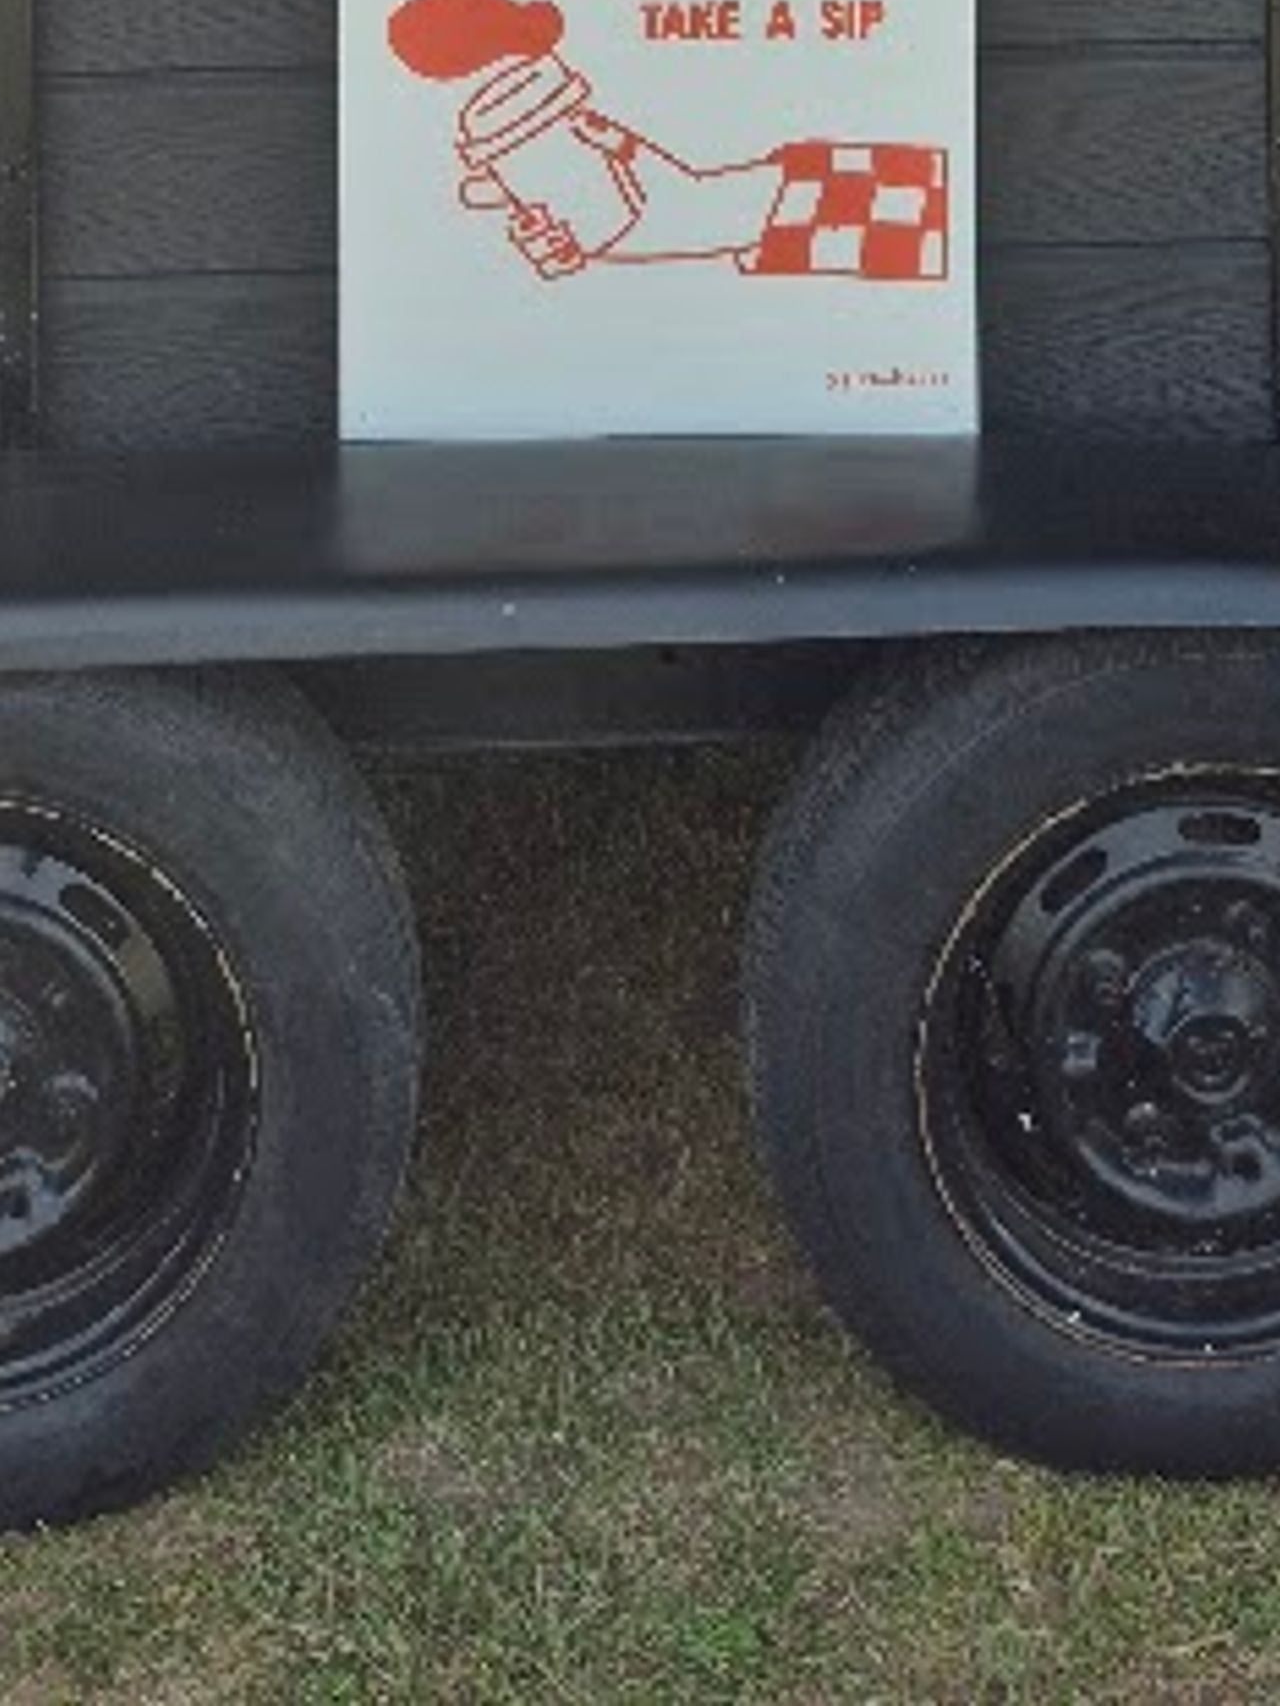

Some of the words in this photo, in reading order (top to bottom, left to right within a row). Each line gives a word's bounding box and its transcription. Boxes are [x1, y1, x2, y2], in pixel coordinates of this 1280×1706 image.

[640, 1, 741, 42] TAKE
[765, 0, 796, 40] A
[820, 0, 885, 40] SIP
